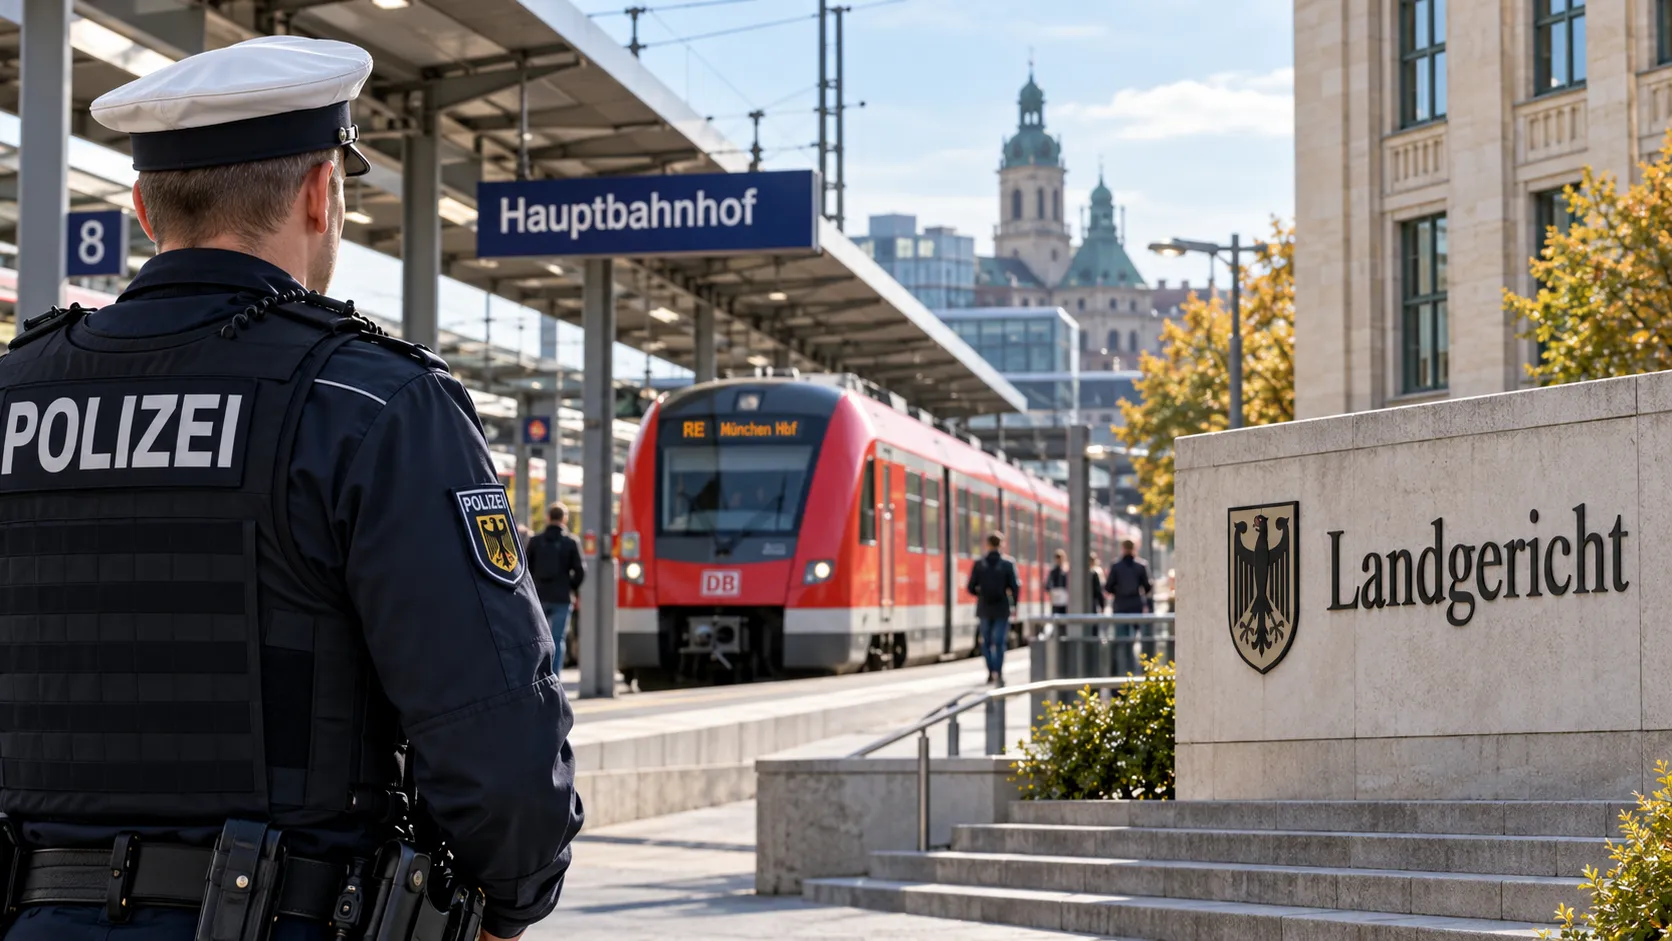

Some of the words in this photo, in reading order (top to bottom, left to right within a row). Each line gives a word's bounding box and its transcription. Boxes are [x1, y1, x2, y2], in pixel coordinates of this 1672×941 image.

[500, 187, 757, 239] Hauptbahnhof
[78, 219, 105, 265] 8
[1, 393, 243, 475] POLIZEI
[683, 421, 705, 438] RE
[720, 421, 772, 436] München
[462, 494, 506, 512] POLIZEI
[706, 575, 735, 592] DB
[1326, 502, 1630, 626] Landgericht
